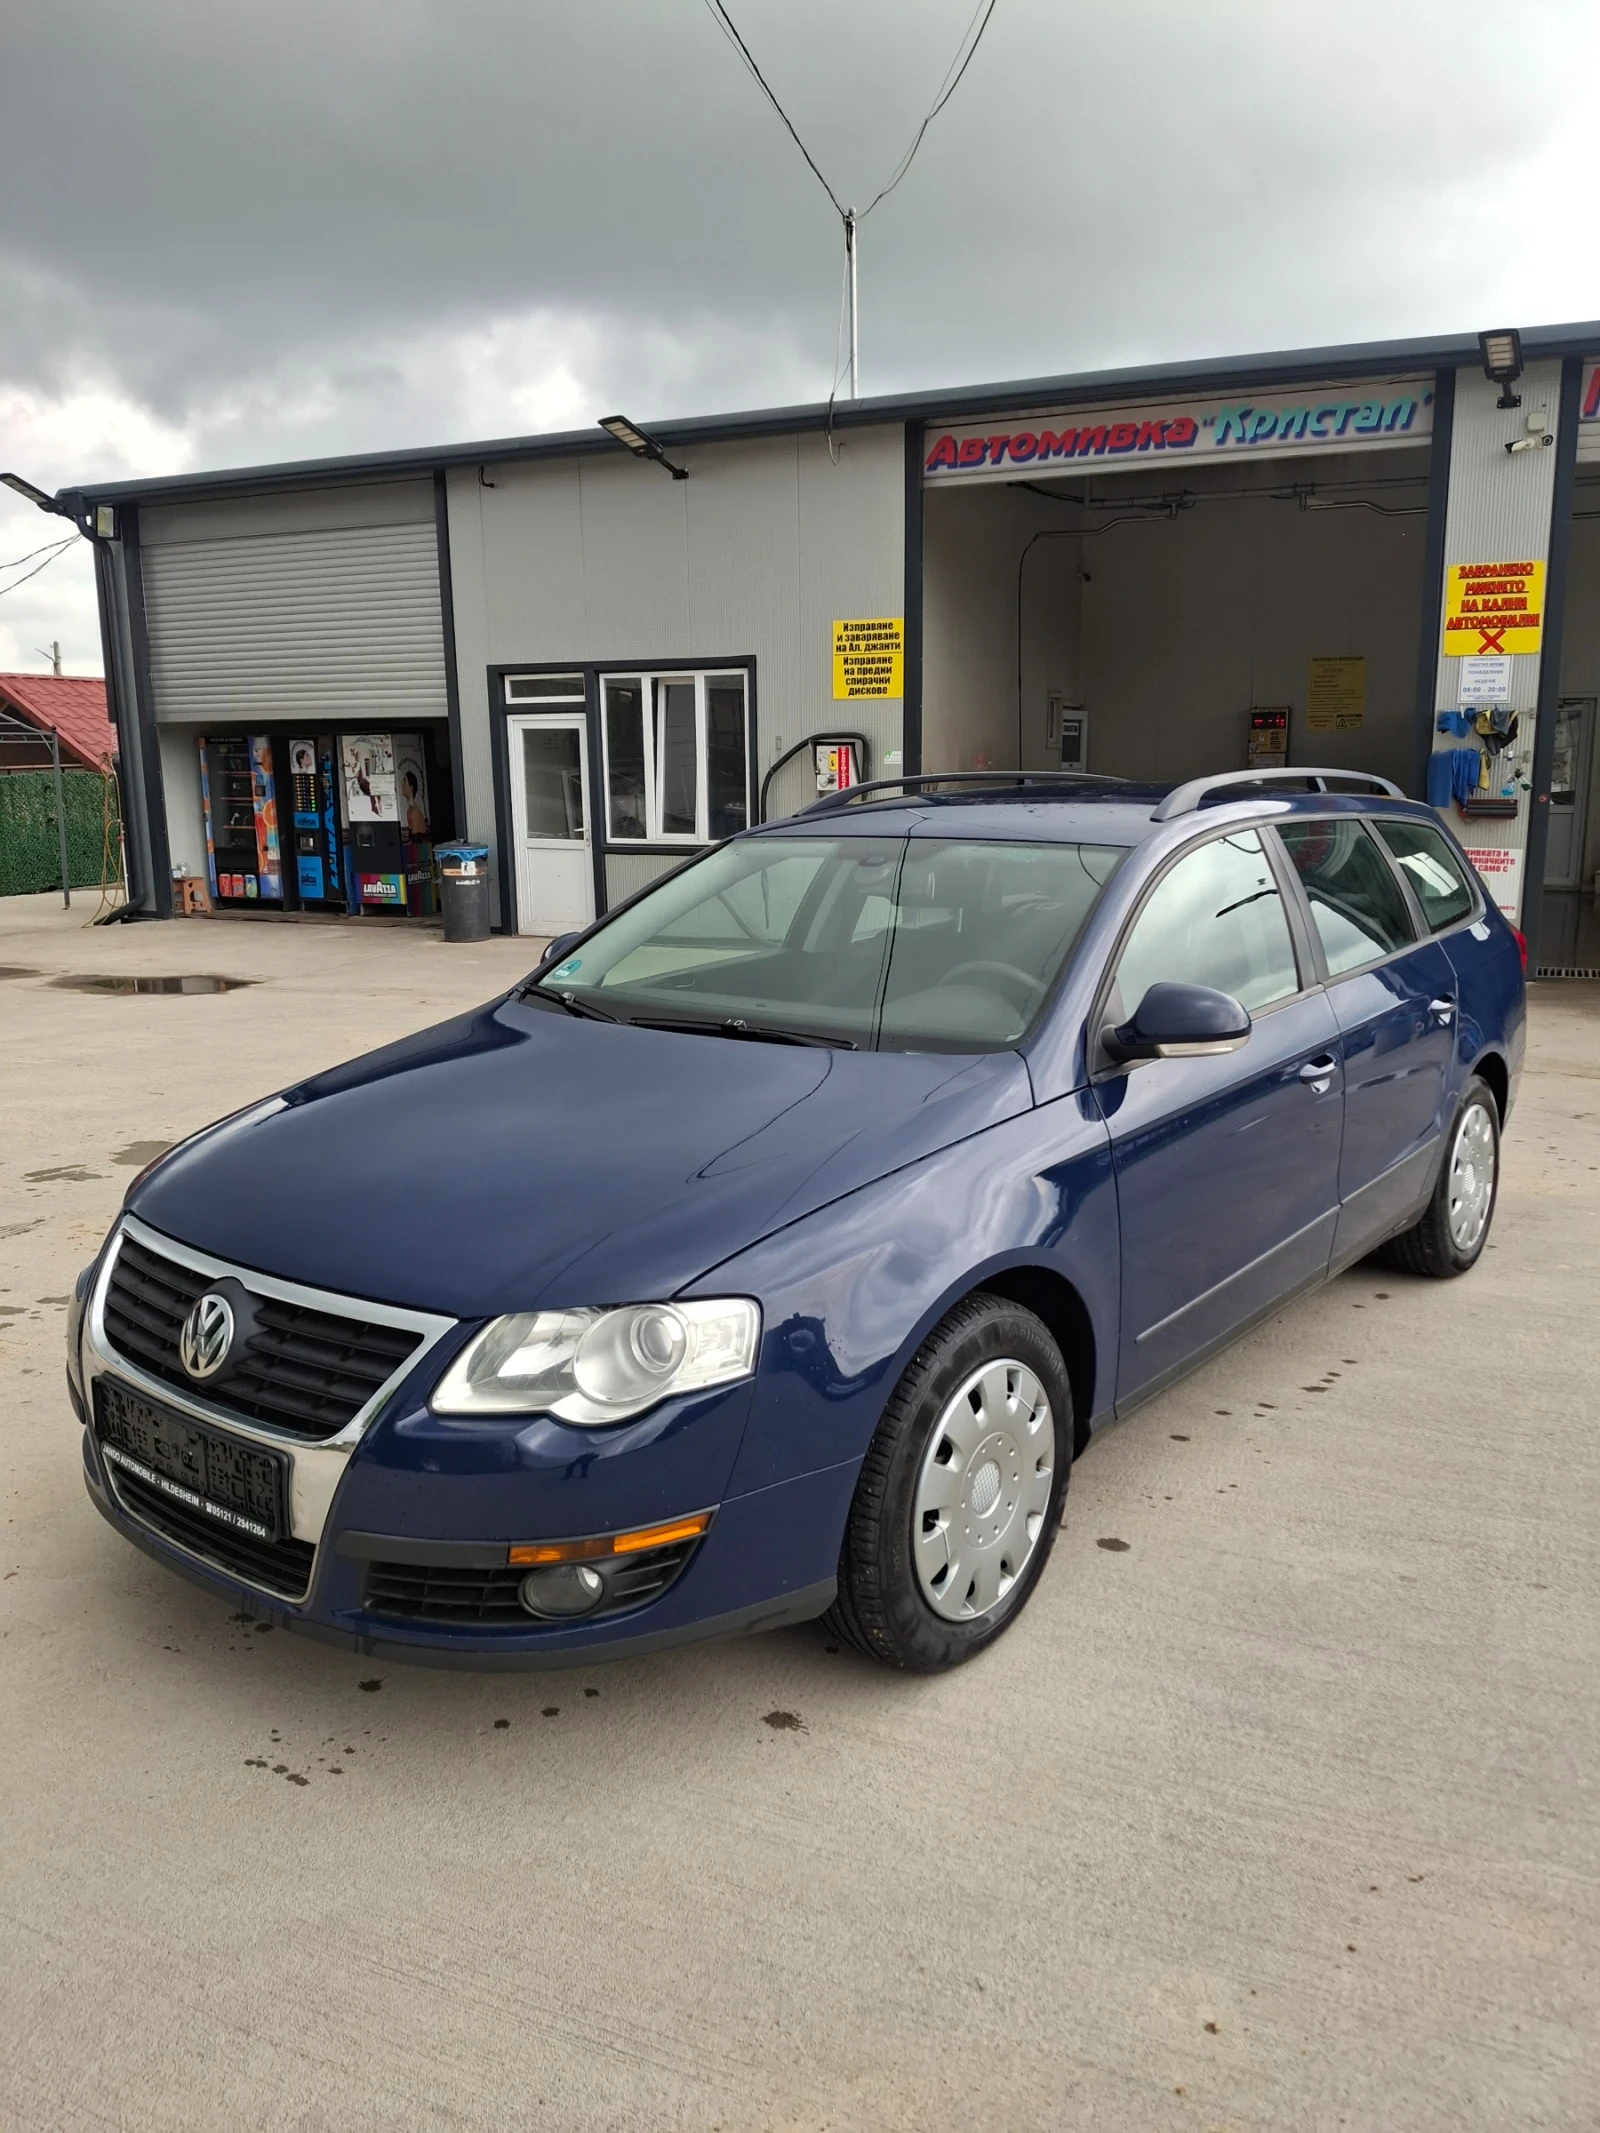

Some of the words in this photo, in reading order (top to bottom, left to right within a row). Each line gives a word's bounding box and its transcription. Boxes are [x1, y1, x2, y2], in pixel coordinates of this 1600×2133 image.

[926, 414, 1198, 472] Автомивка
[1458, 562, 1534, 578] ЗАБРАНЕНО
[1461, 599, 1479, 612] НА
[1481, 597, 1527, 611] КАЛНИ
[1446, 613, 1540, 630] АВТОМОБИЛИ!
[843, 622, 894, 632] Изправяне
[837, 634, 843, 642] и
[844, 632, 900, 642] заваряване
[836, 644, 846, 652] на
[849, 643, 862, 652] Ал.
[864, 642, 900, 652] джанти
[843, 656, 893, 666] Изправяне
[844, 667, 854, 676] на
[857, 666, 892, 676] предни
[846, 676, 890, 686] спирачни
[848, 686, 888, 696] дискове
[363, 881, 396, 893] LAVAZZA
[103, 1444, 121, 1462] JANDO
[121, 1456, 156, 1484] AUTOMOBILE
[161, 1479, 200, 1507] HILDESHEIM
[237, 1517, 266, 1537] 2941264
